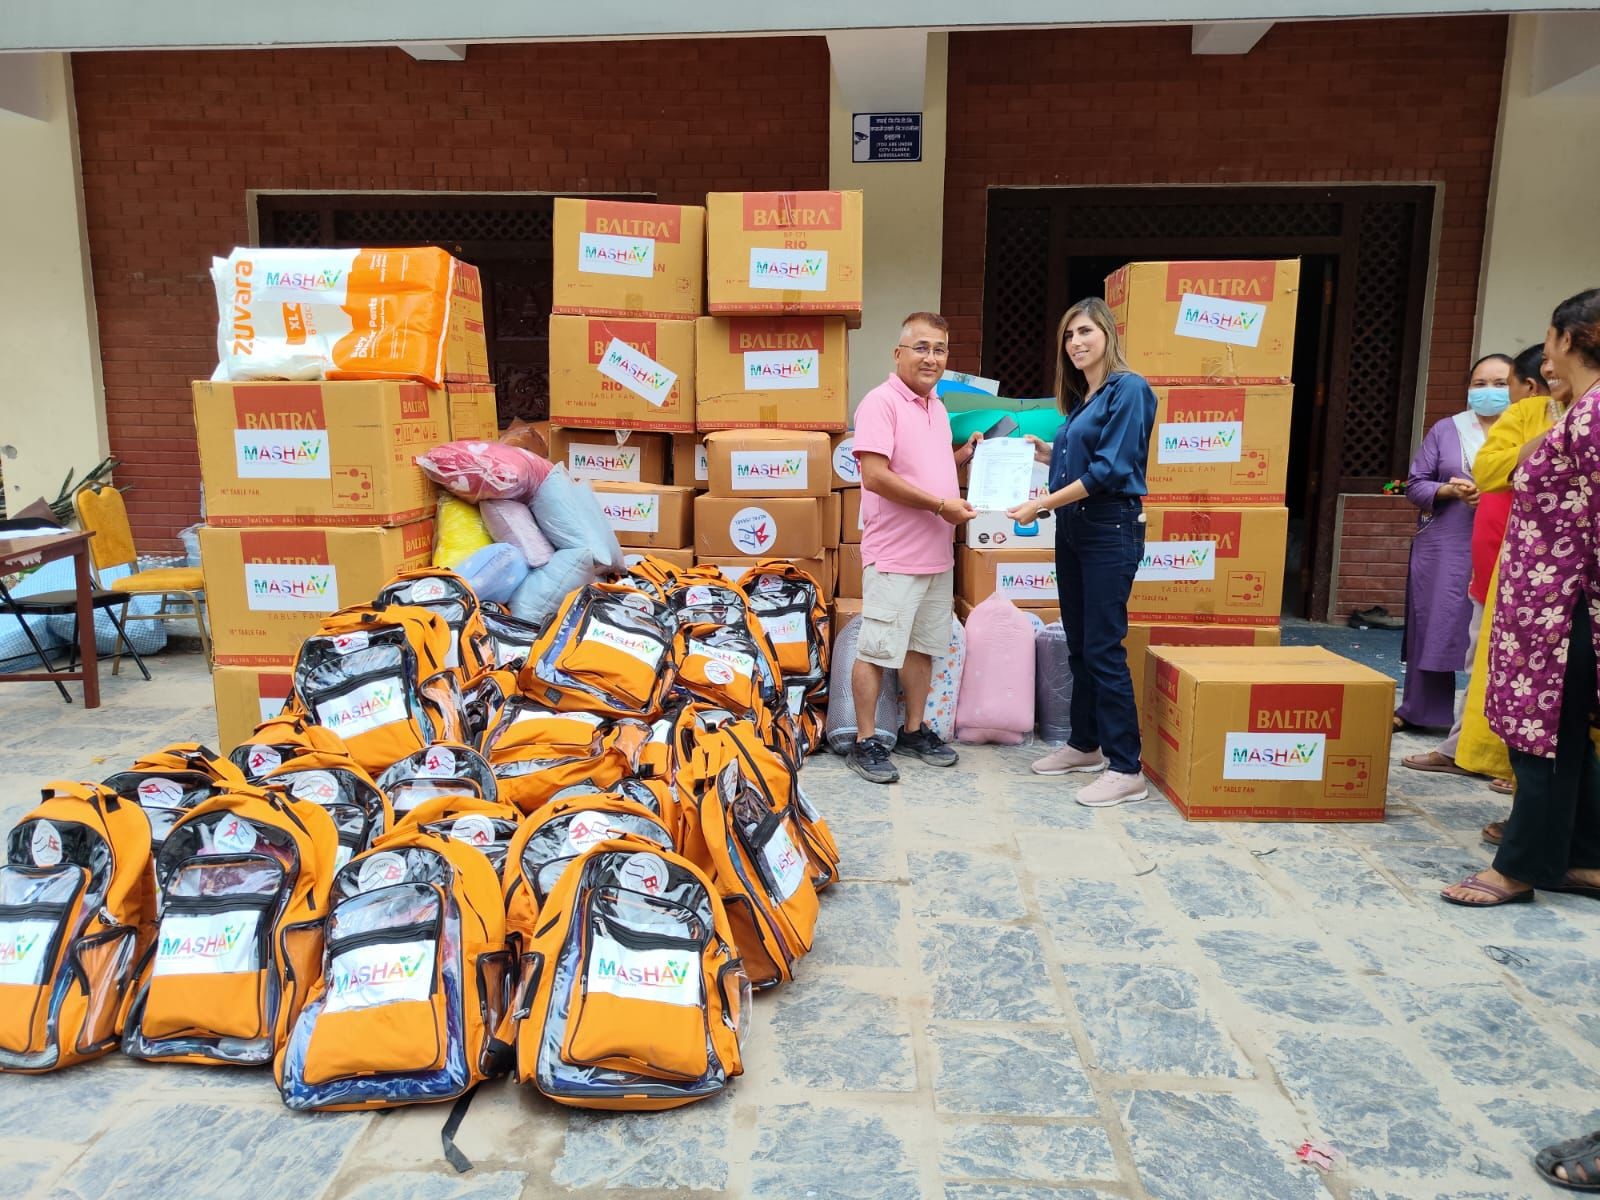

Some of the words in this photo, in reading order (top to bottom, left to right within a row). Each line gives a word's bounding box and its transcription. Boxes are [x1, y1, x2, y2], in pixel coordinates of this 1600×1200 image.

[754, 207, 831, 226] BALTRA
[596, 217, 669, 238] BALTRA
[584, 245, 650, 264] MASHAV
[784, 239, 807, 250] RIO
[652, 263, 666, 273] AN
[756, 258, 824, 276] MASHAV
[265, 269, 343, 289] MASHAV
[1178, 278, 1261, 296] BALTRA
[232, 260, 255, 356] zuvara
[368, 297, 378, 328] Pants
[289, 313, 301, 331] XL
[1185, 312, 1258, 334] MASHAV
[740, 332, 813, 350] BALTRA
[607, 352, 669, 389] MASHAV
[750, 357, 813, 379] MASHAV
[601, 381, 623, 391] RIO
[245, 412, 316, 430] BALTRA
[1174, 410, 1236, 423] BALTRA
[1165, 429, 1236, 450] MASHAV
[244, 439, 322, 461] MASHAV
[574, 453, 636, 470] MASHAV
[737, 458, 802, 476] MASHAV
[603, 497, 654, 519] ASHAV
[1139, 548, 1209, 567] MASHAV
[254, 574, 329, 595] MASHAV
[1003, 571, 1057, 587] MASHA
[591, 626, 660, 655] MASHAV
[327, 686, 394, 729] MASHAV
[1257, 710, 1332, 729] BALTRA
[1233, 742, 1318, 764] MASHAV
[161, 922, 246, 956] MASHAV
[336, 952, 426, 993] MASHAV
[598, 957, 690, 985] MASHAV
